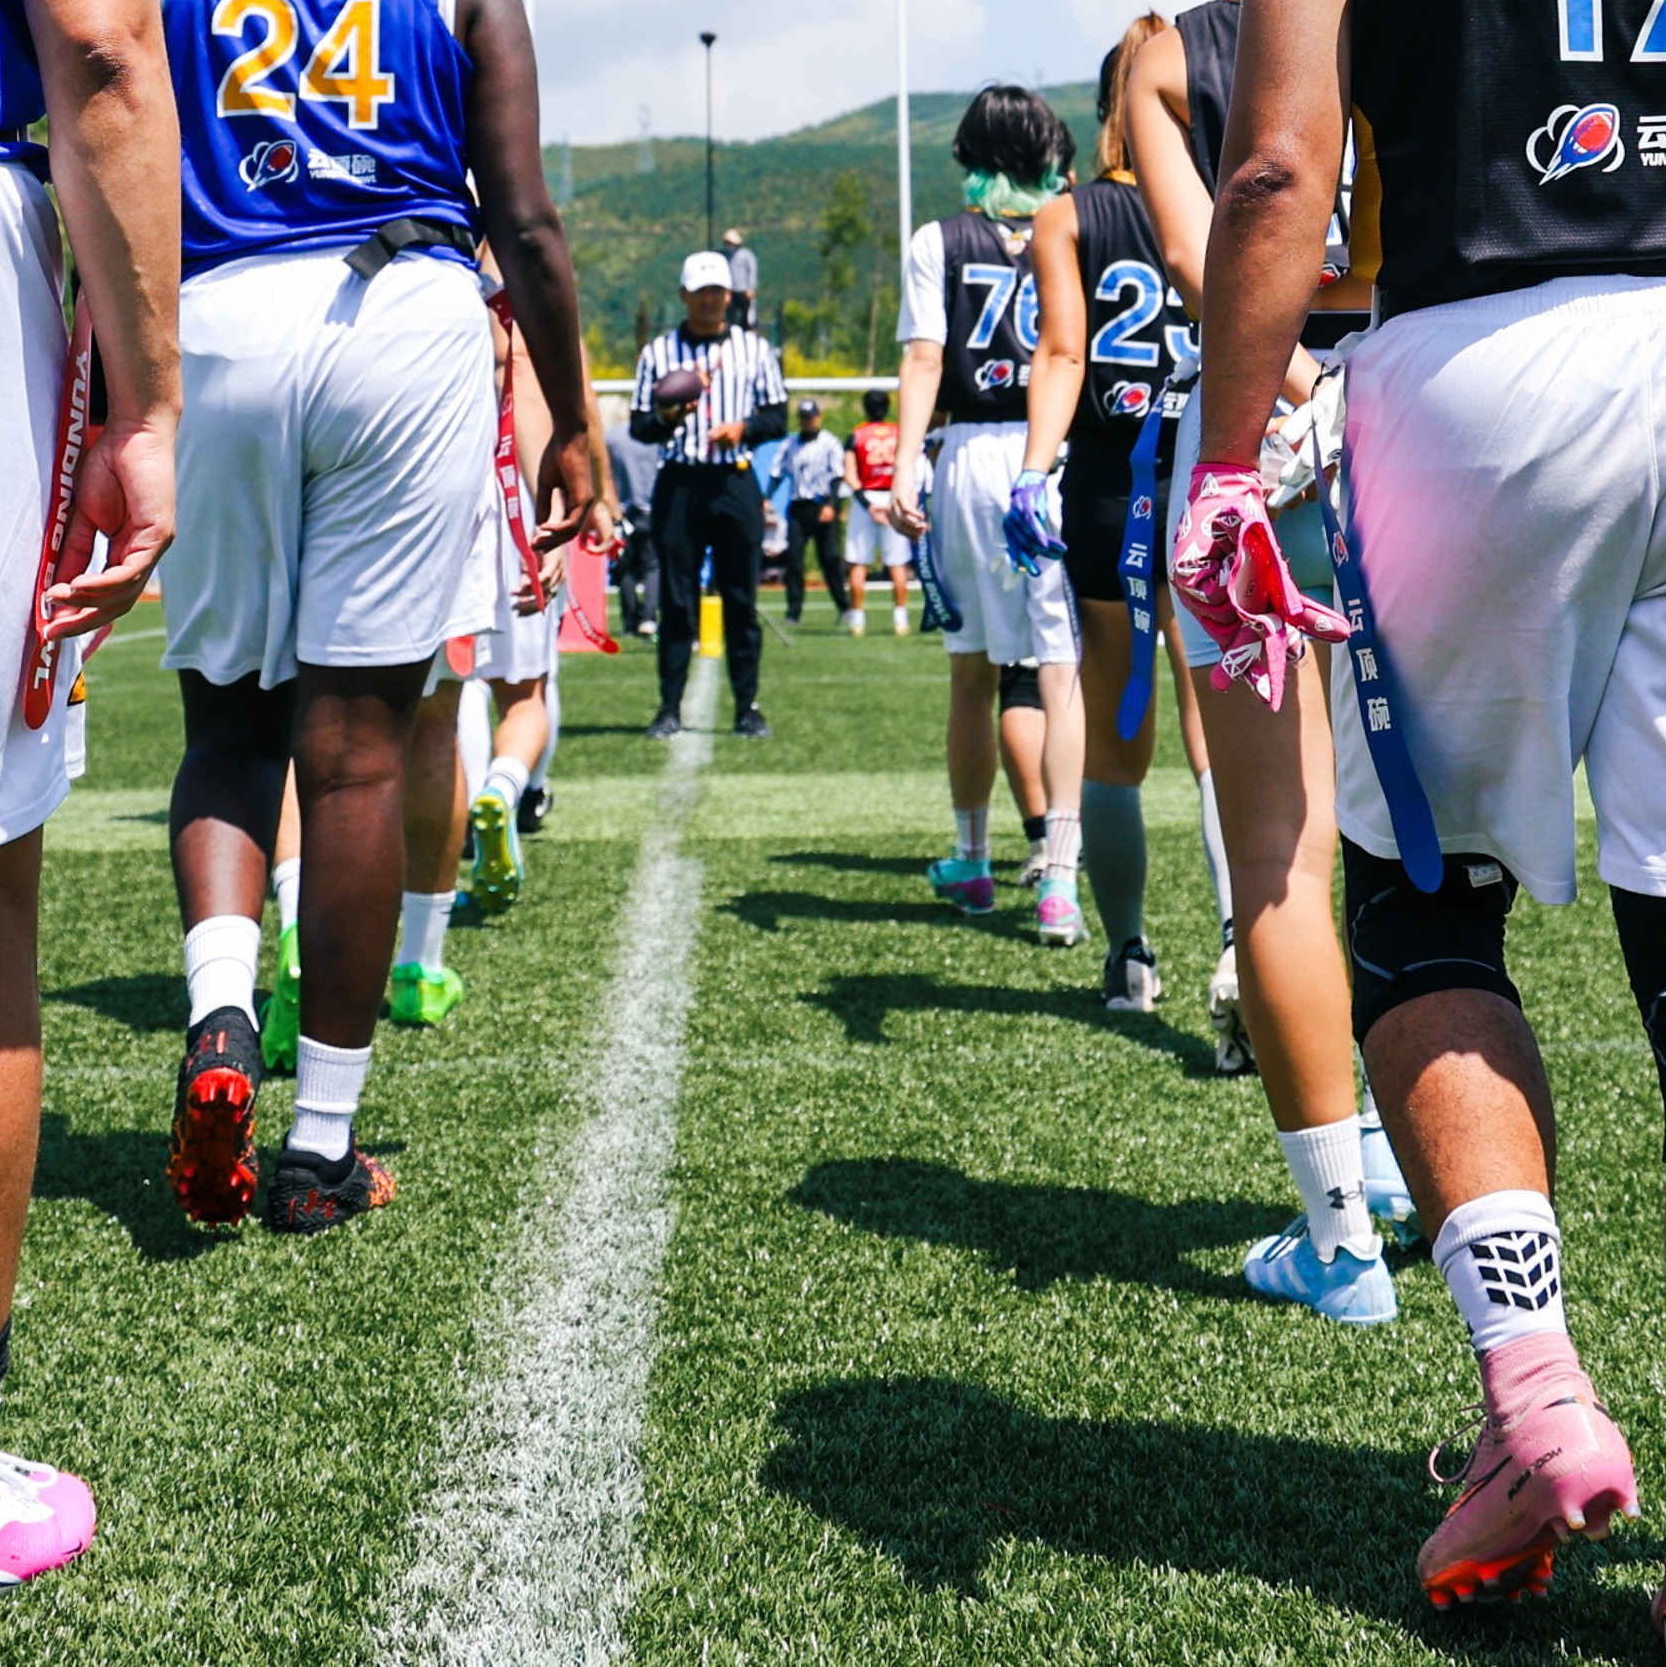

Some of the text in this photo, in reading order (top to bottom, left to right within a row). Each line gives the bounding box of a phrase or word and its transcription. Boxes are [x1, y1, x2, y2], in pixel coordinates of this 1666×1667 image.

[49, 350, 88, 552] YUNDING
[1125, 542, 1150, 634] 云顶碗
[1348, 598, 1391, 732] 云顶碗
